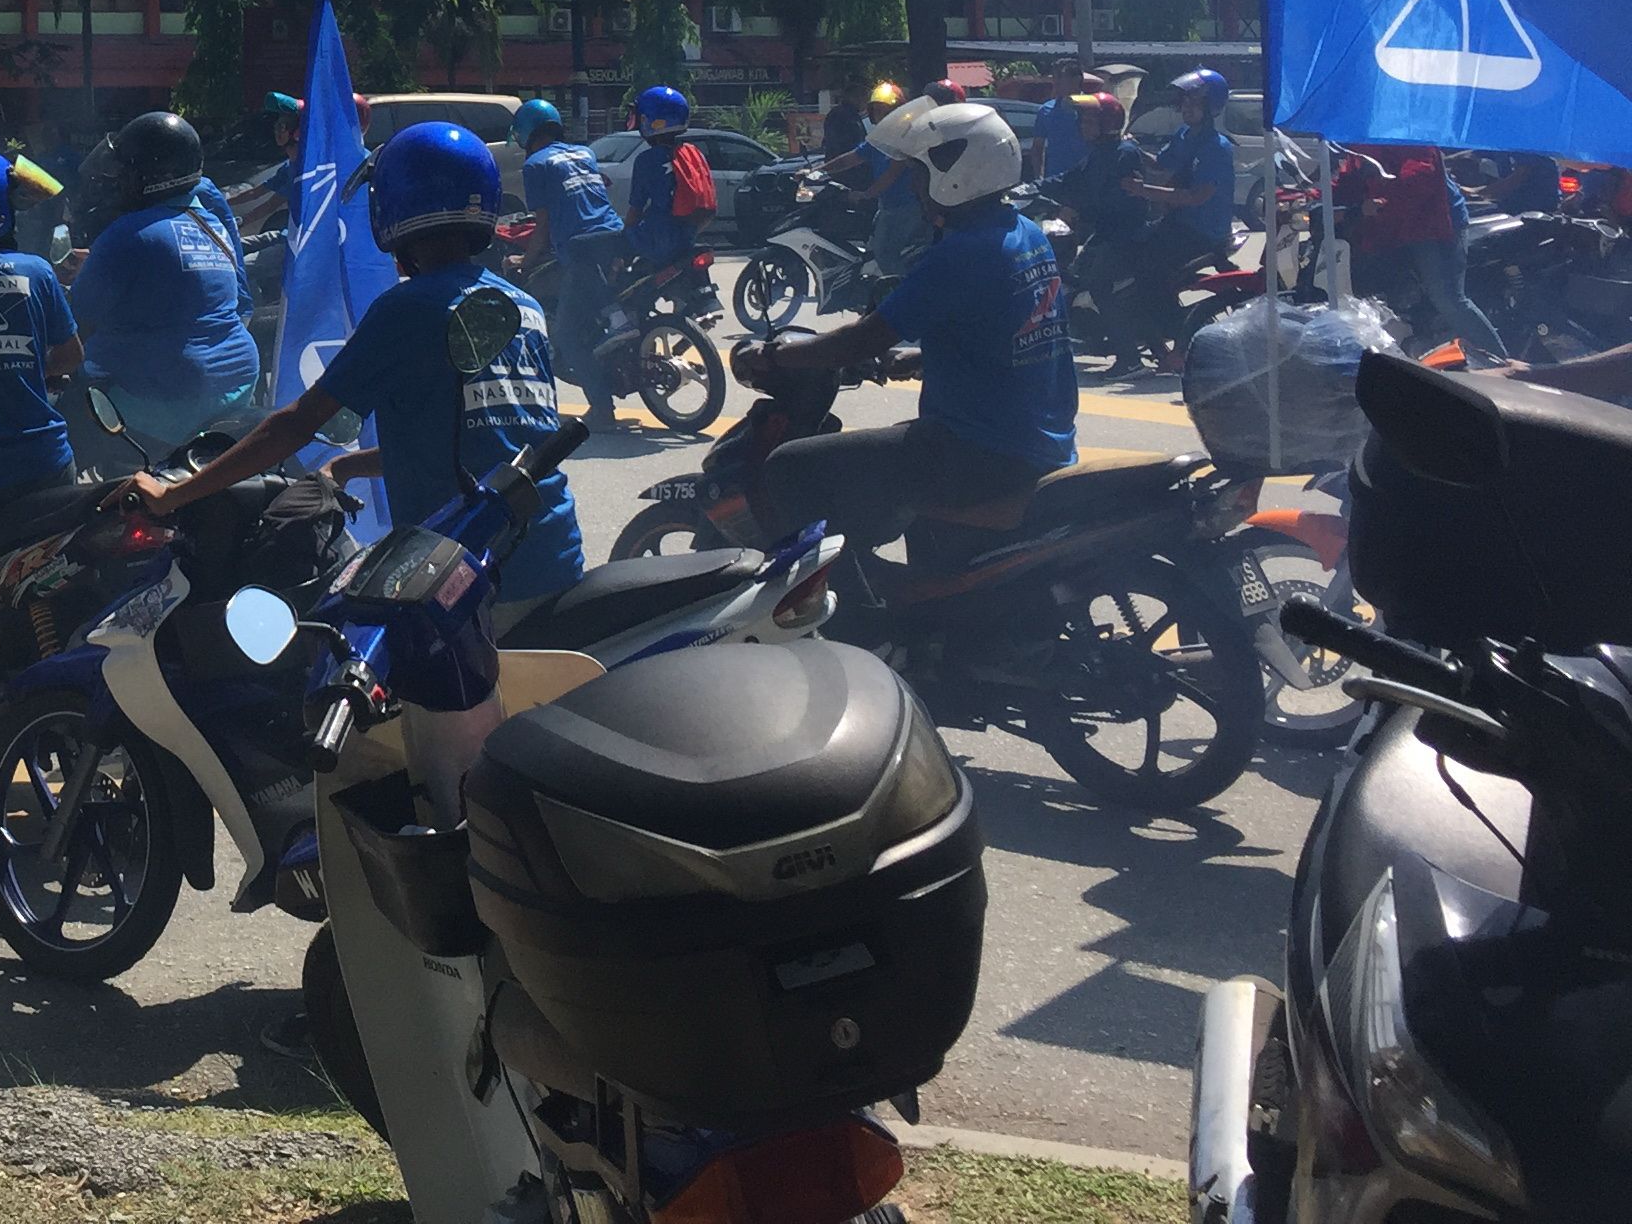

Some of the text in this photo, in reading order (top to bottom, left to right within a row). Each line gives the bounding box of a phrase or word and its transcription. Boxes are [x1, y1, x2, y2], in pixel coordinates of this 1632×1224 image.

[589, 66, 634, 82] SEKOLAH
[473, 386, 554, 403] NASIONAL
[251, 775, 304, 806] YAMAHA
[771, 846, 836, 881] GIVI
[422, 956, 463, 981] HONDA
